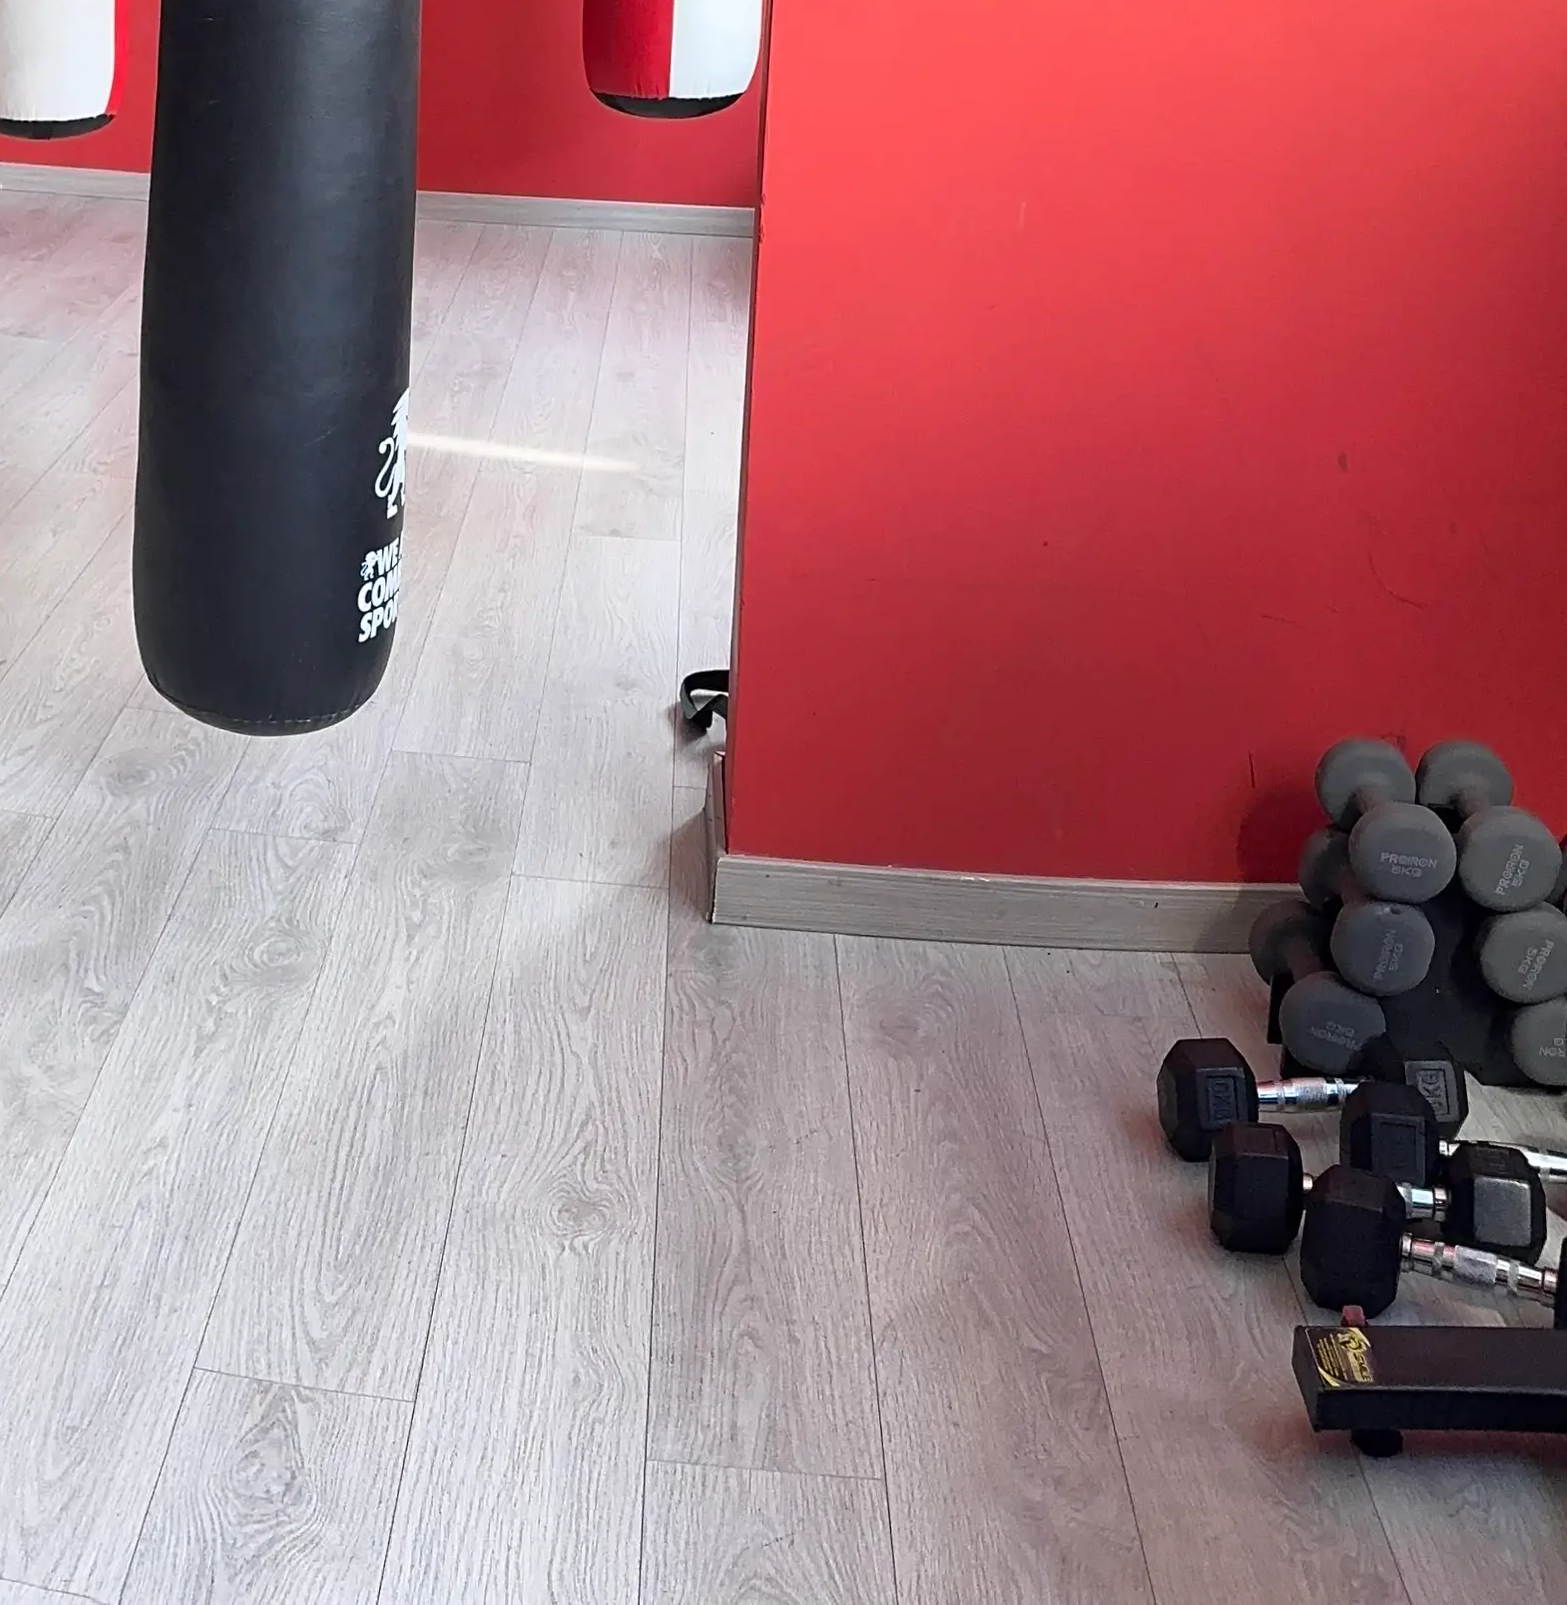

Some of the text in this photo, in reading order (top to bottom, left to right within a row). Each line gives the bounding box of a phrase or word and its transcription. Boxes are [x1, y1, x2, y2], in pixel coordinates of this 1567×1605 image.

[376, 537, 400, 576] WE
[1380, 851, 1437, 869] PROIRON
[1494, 844, 1524, 896] PROIRON
[1517, 946, 1537, 975] 5KG
